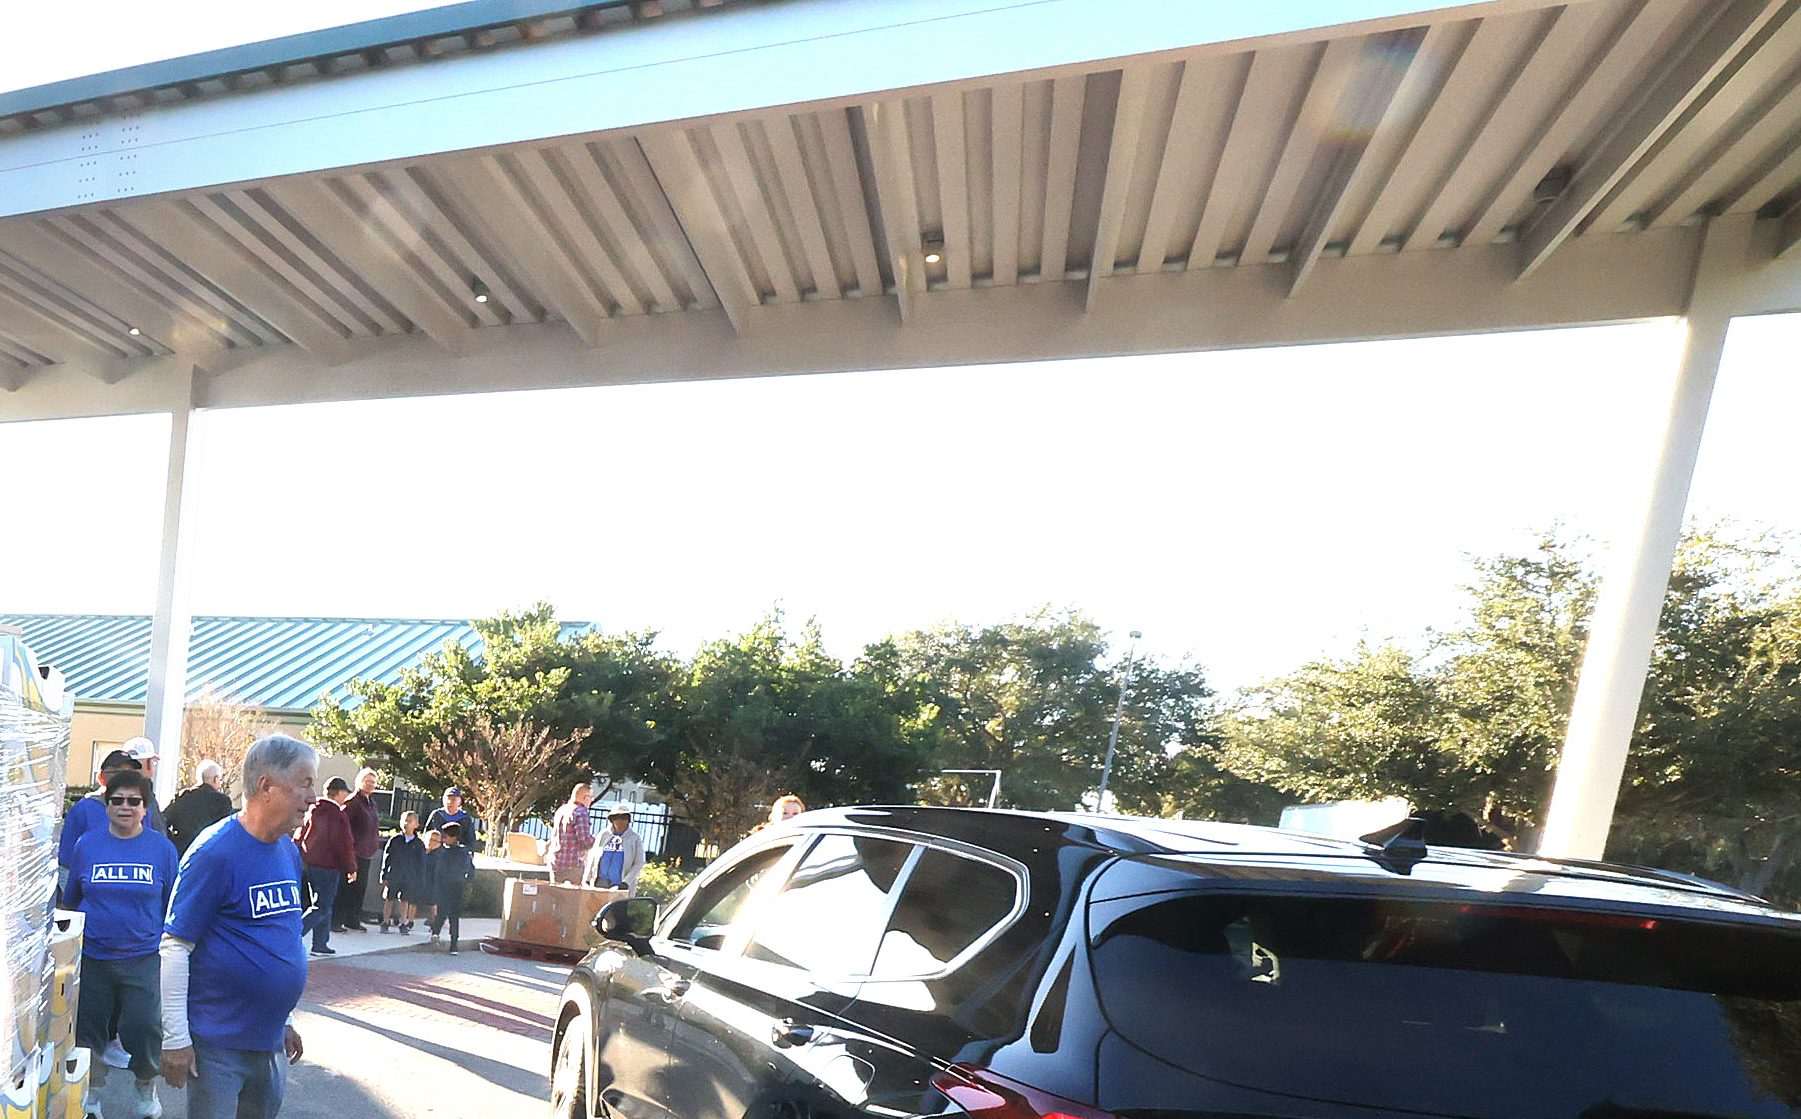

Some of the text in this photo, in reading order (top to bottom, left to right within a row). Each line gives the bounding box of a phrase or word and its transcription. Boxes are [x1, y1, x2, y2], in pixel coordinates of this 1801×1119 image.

[95, 867, 151, 880] ALL IN
[255, 888, 290, 912] ALL
